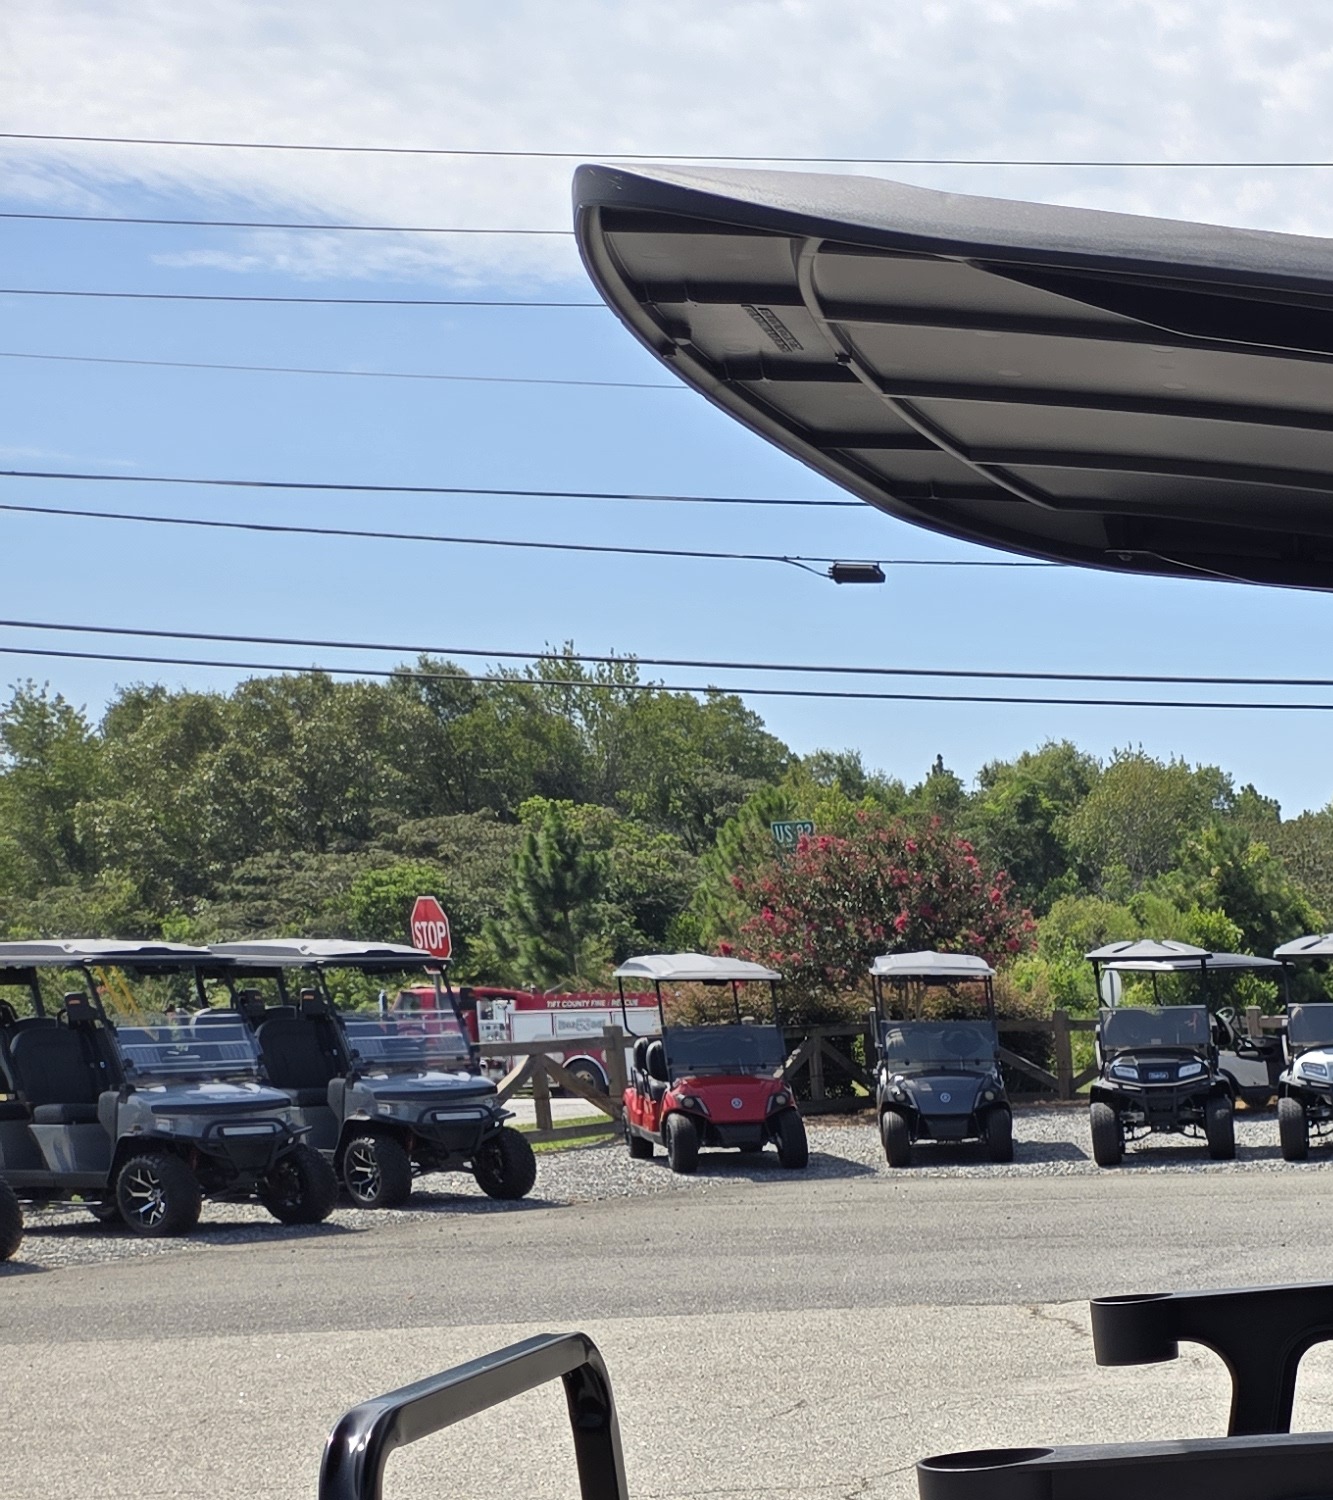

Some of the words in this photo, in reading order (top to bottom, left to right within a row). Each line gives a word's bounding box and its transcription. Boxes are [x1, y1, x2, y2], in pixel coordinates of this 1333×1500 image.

[775, 825, 793, 843] US
[414, 921, 446, 949] STOP
[547, 1000, 560, 1008] TIFT
[562, 1000, 589, 1008] COUNTY
[591, 999, 605, 1007] FIRE
[612, 999, 639, 1007] RECUE
